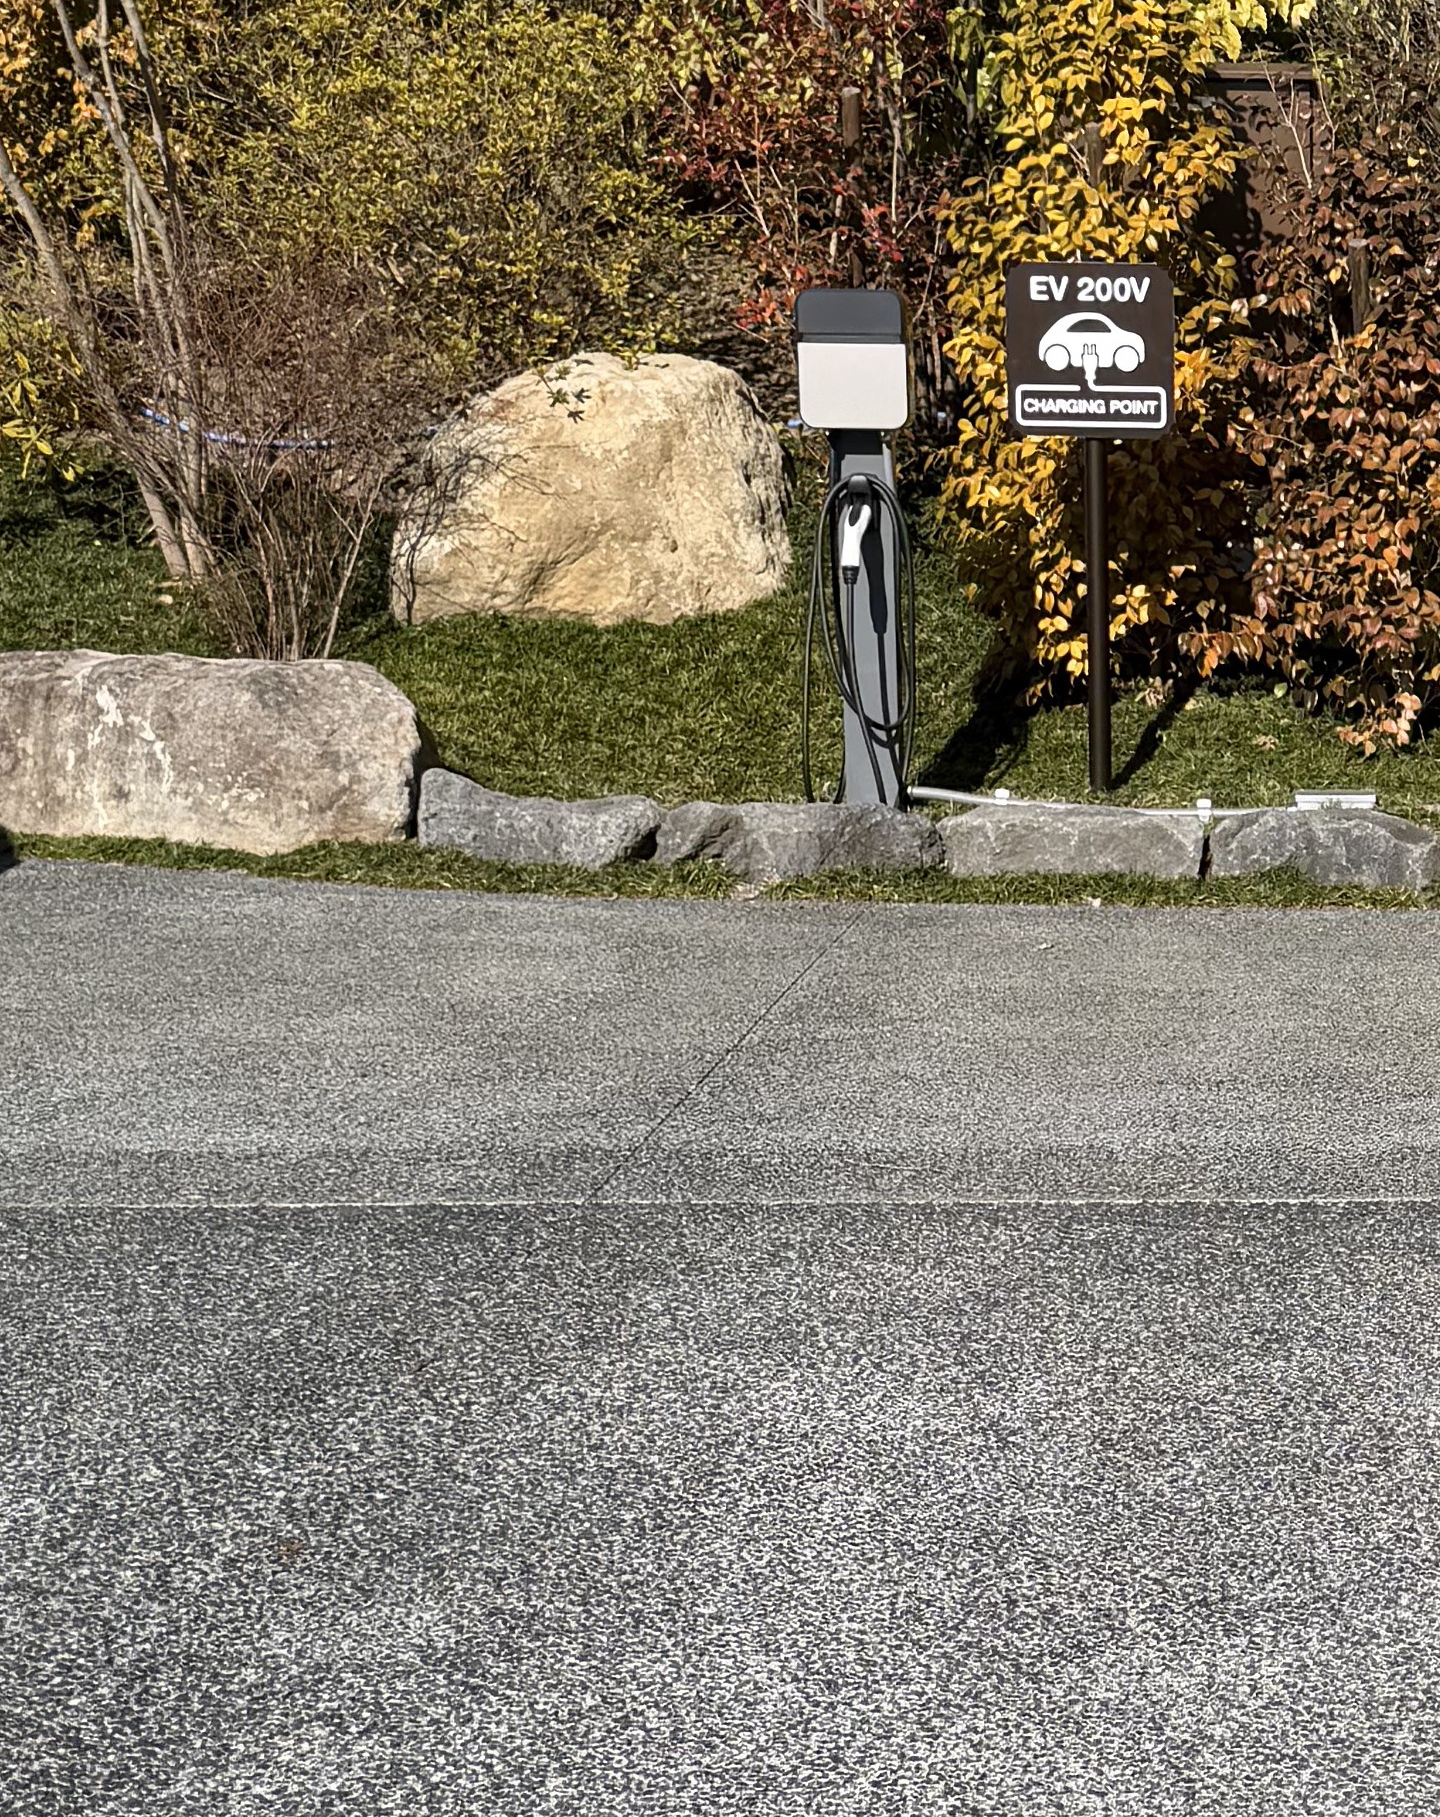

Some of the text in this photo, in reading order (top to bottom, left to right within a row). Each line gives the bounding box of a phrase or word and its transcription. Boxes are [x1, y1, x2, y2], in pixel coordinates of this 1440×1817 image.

[1029, 275, 1151, 303] EV 200V
[1023, 397, 1159, 415] CHARGING POINT
